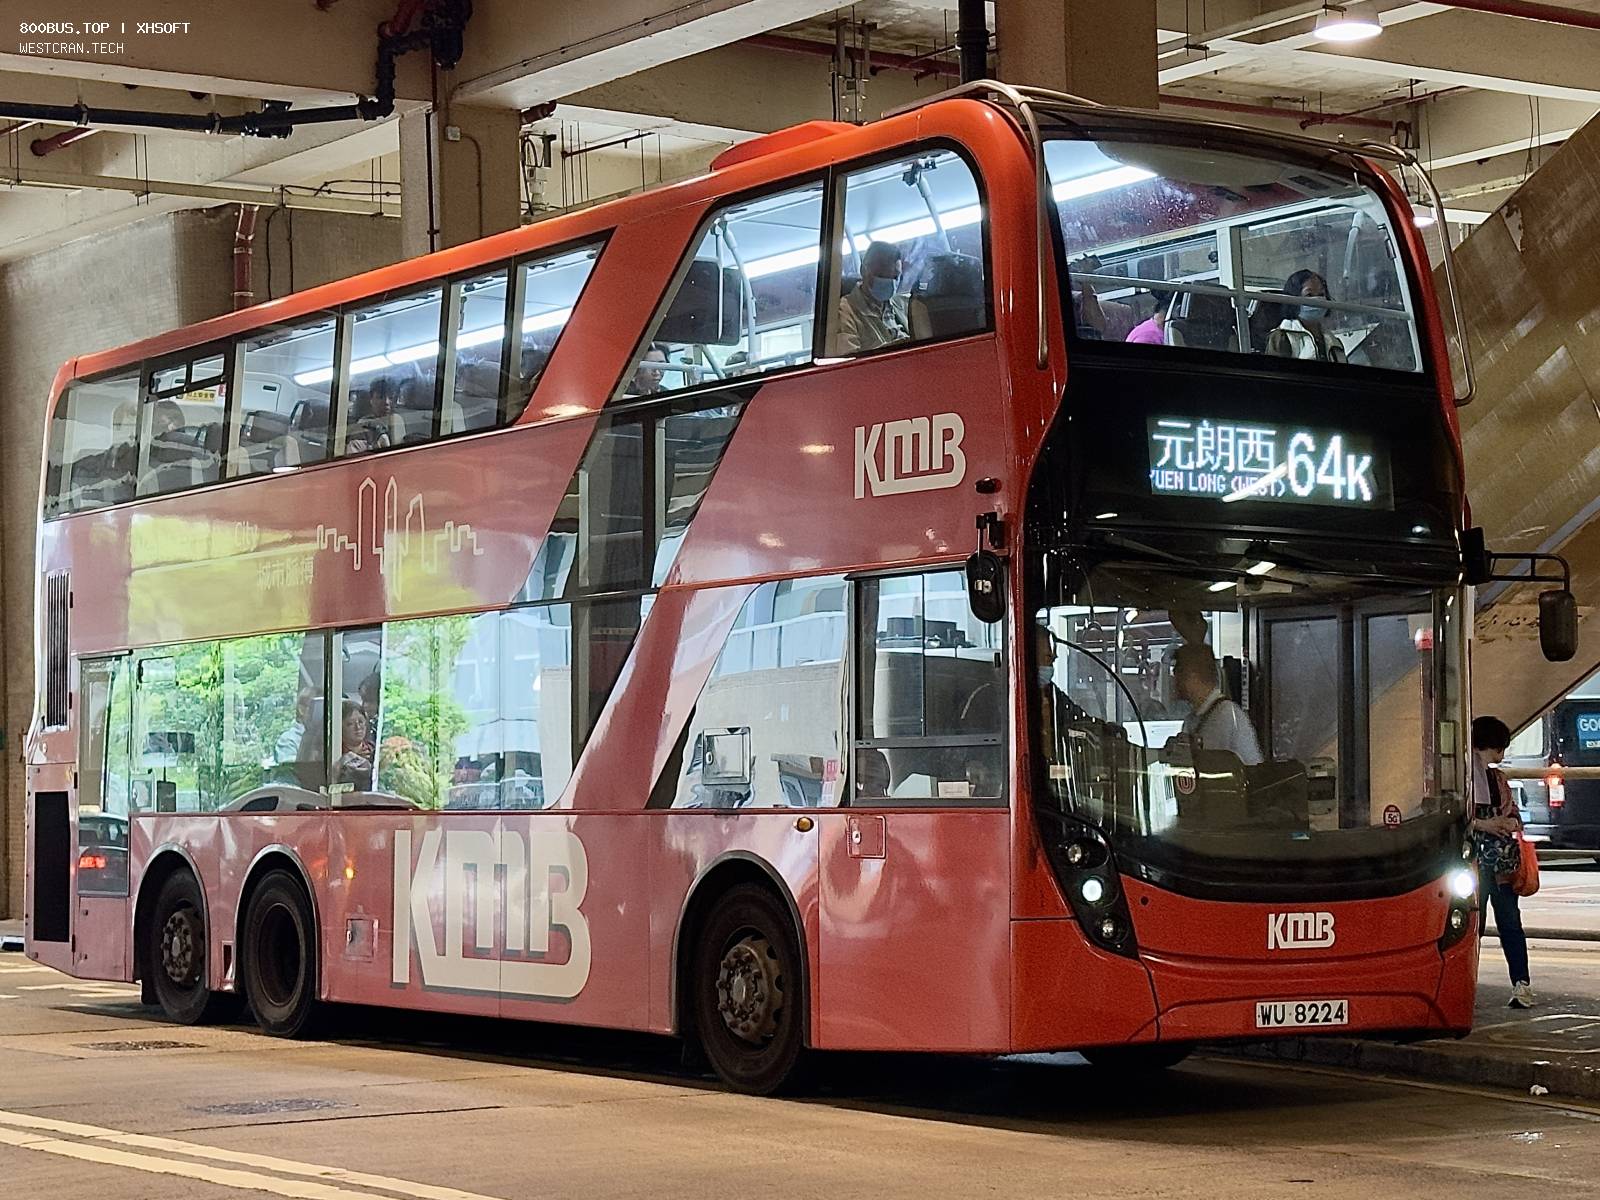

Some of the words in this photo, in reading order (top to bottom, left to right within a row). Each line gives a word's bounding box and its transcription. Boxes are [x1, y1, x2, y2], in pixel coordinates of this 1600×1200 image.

[1152, 419, 1277, 473] 元朗西
[1188, 472, 1227, 493] LONG
[1287, 432, 1372, 502] 64K
[1260, 1004, 1286, 1026] WU
[1294, 1001, 1345, 1024] 8224
